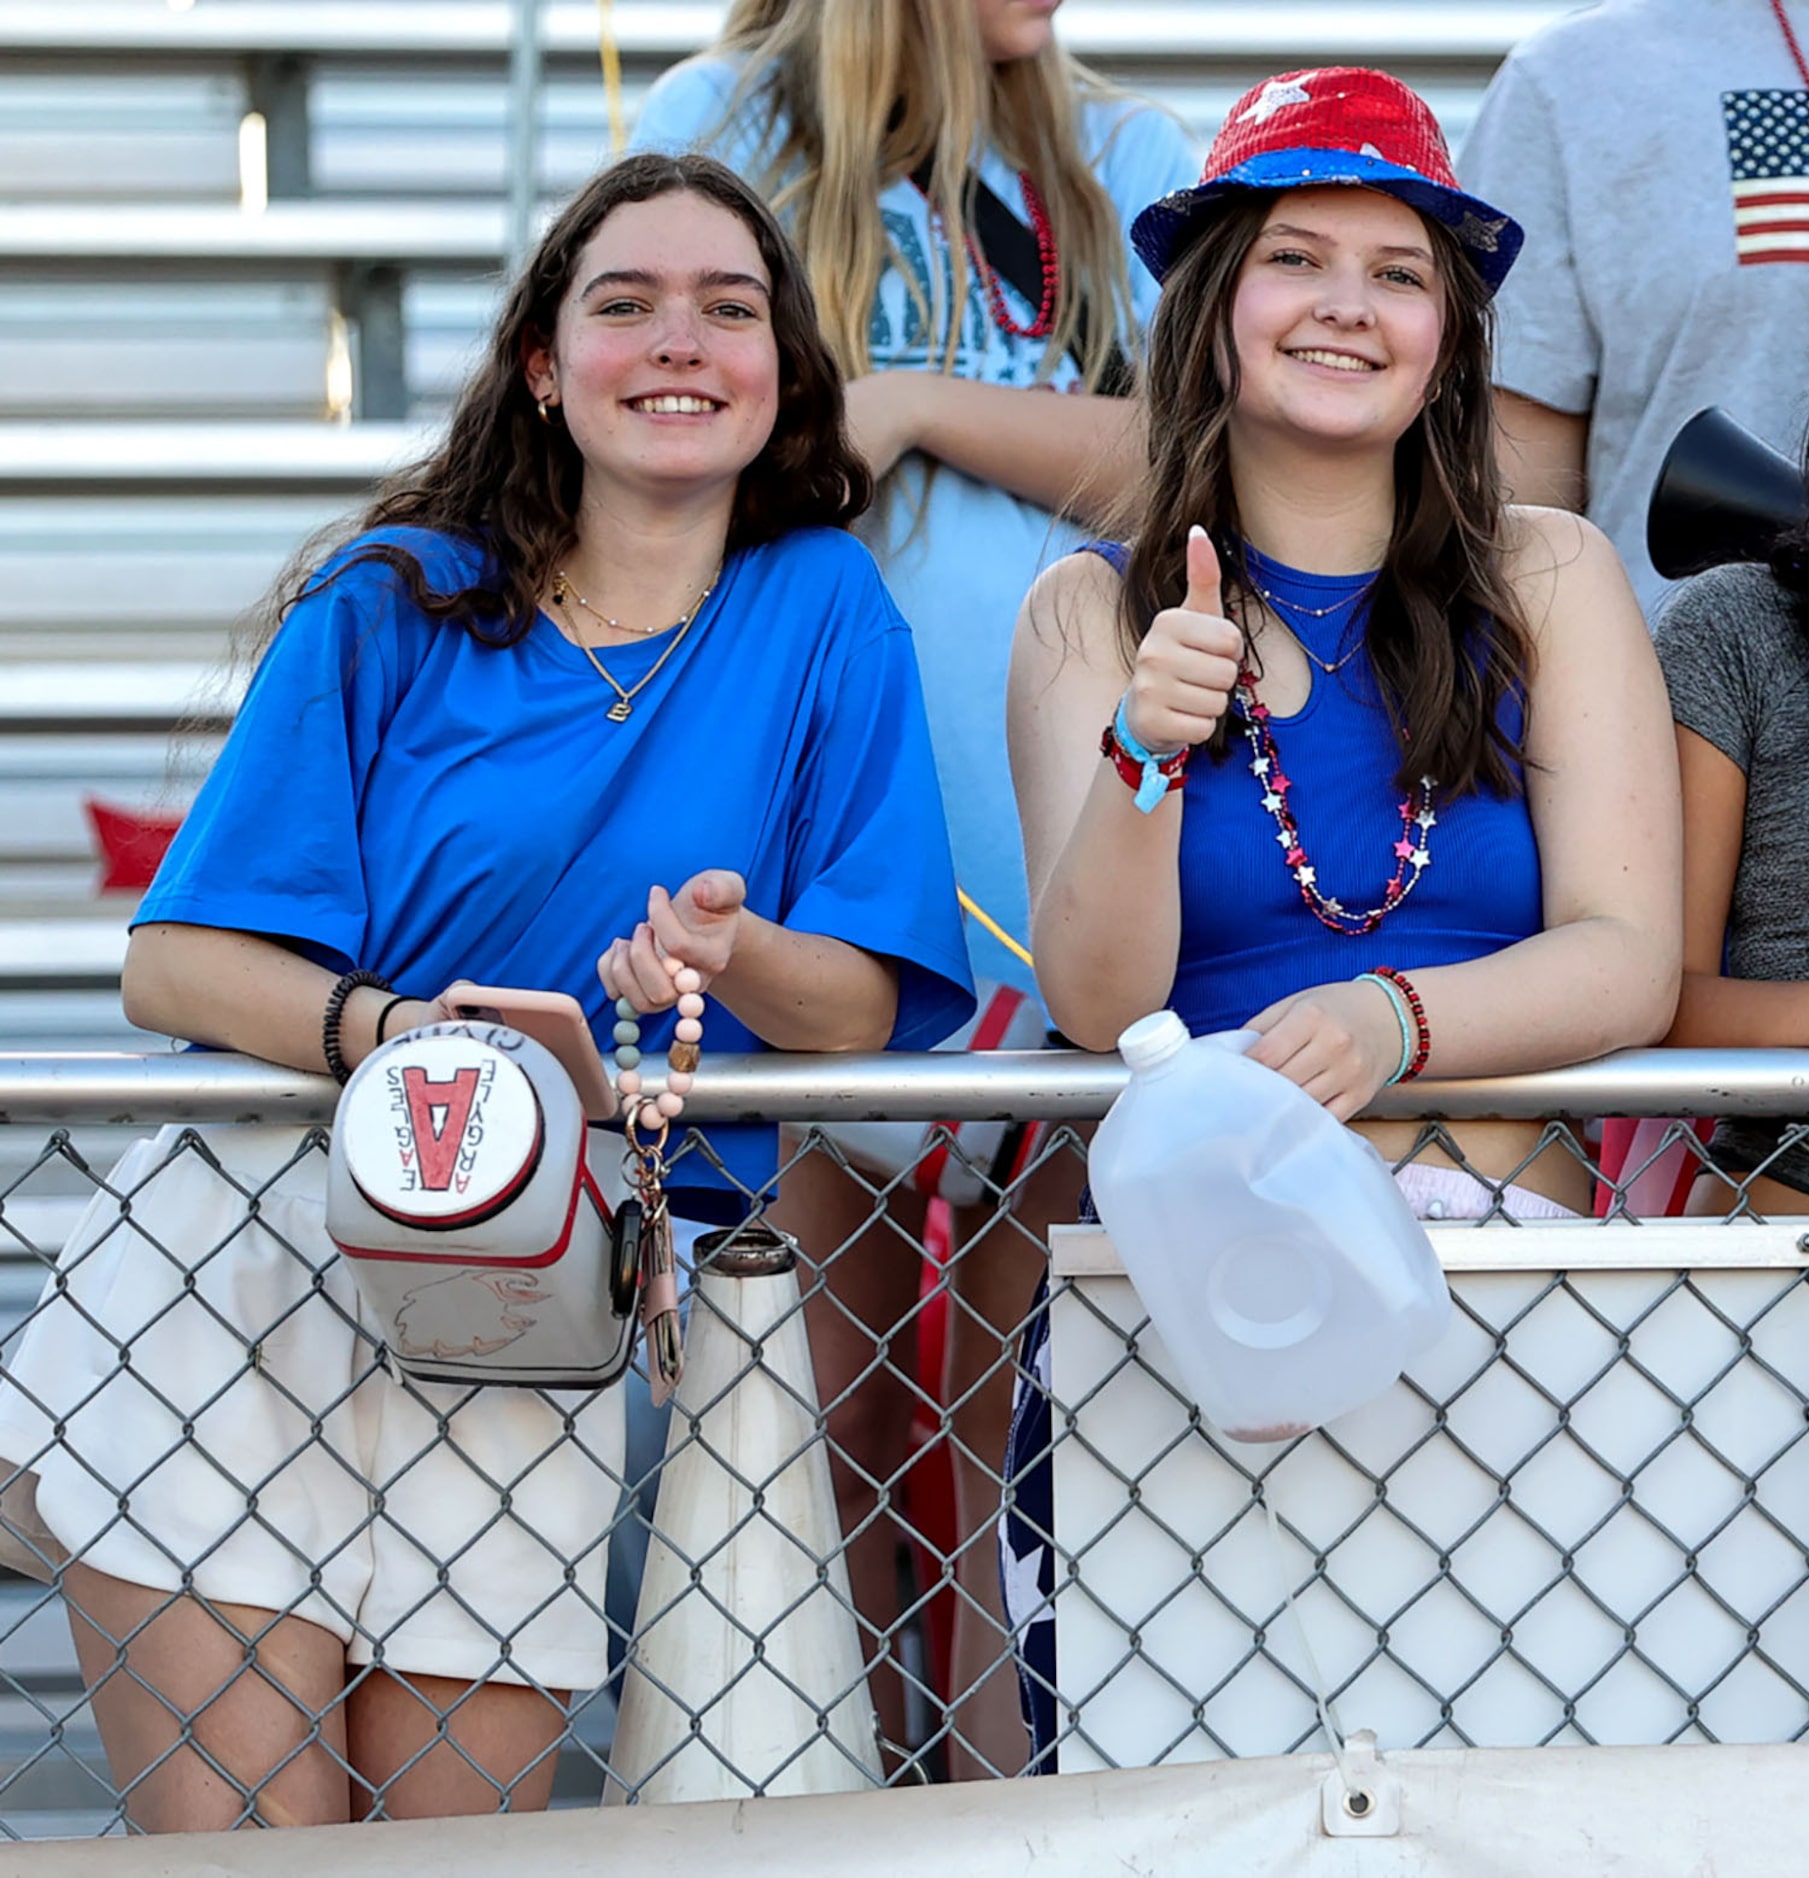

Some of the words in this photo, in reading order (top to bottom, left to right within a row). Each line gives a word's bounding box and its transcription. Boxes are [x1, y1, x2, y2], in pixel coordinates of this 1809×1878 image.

[386, 1065, 417, 1192] EAGLES
[401, 1066, 481, 1191] A
[454, 1058, 496, 1194] ARGYLE
